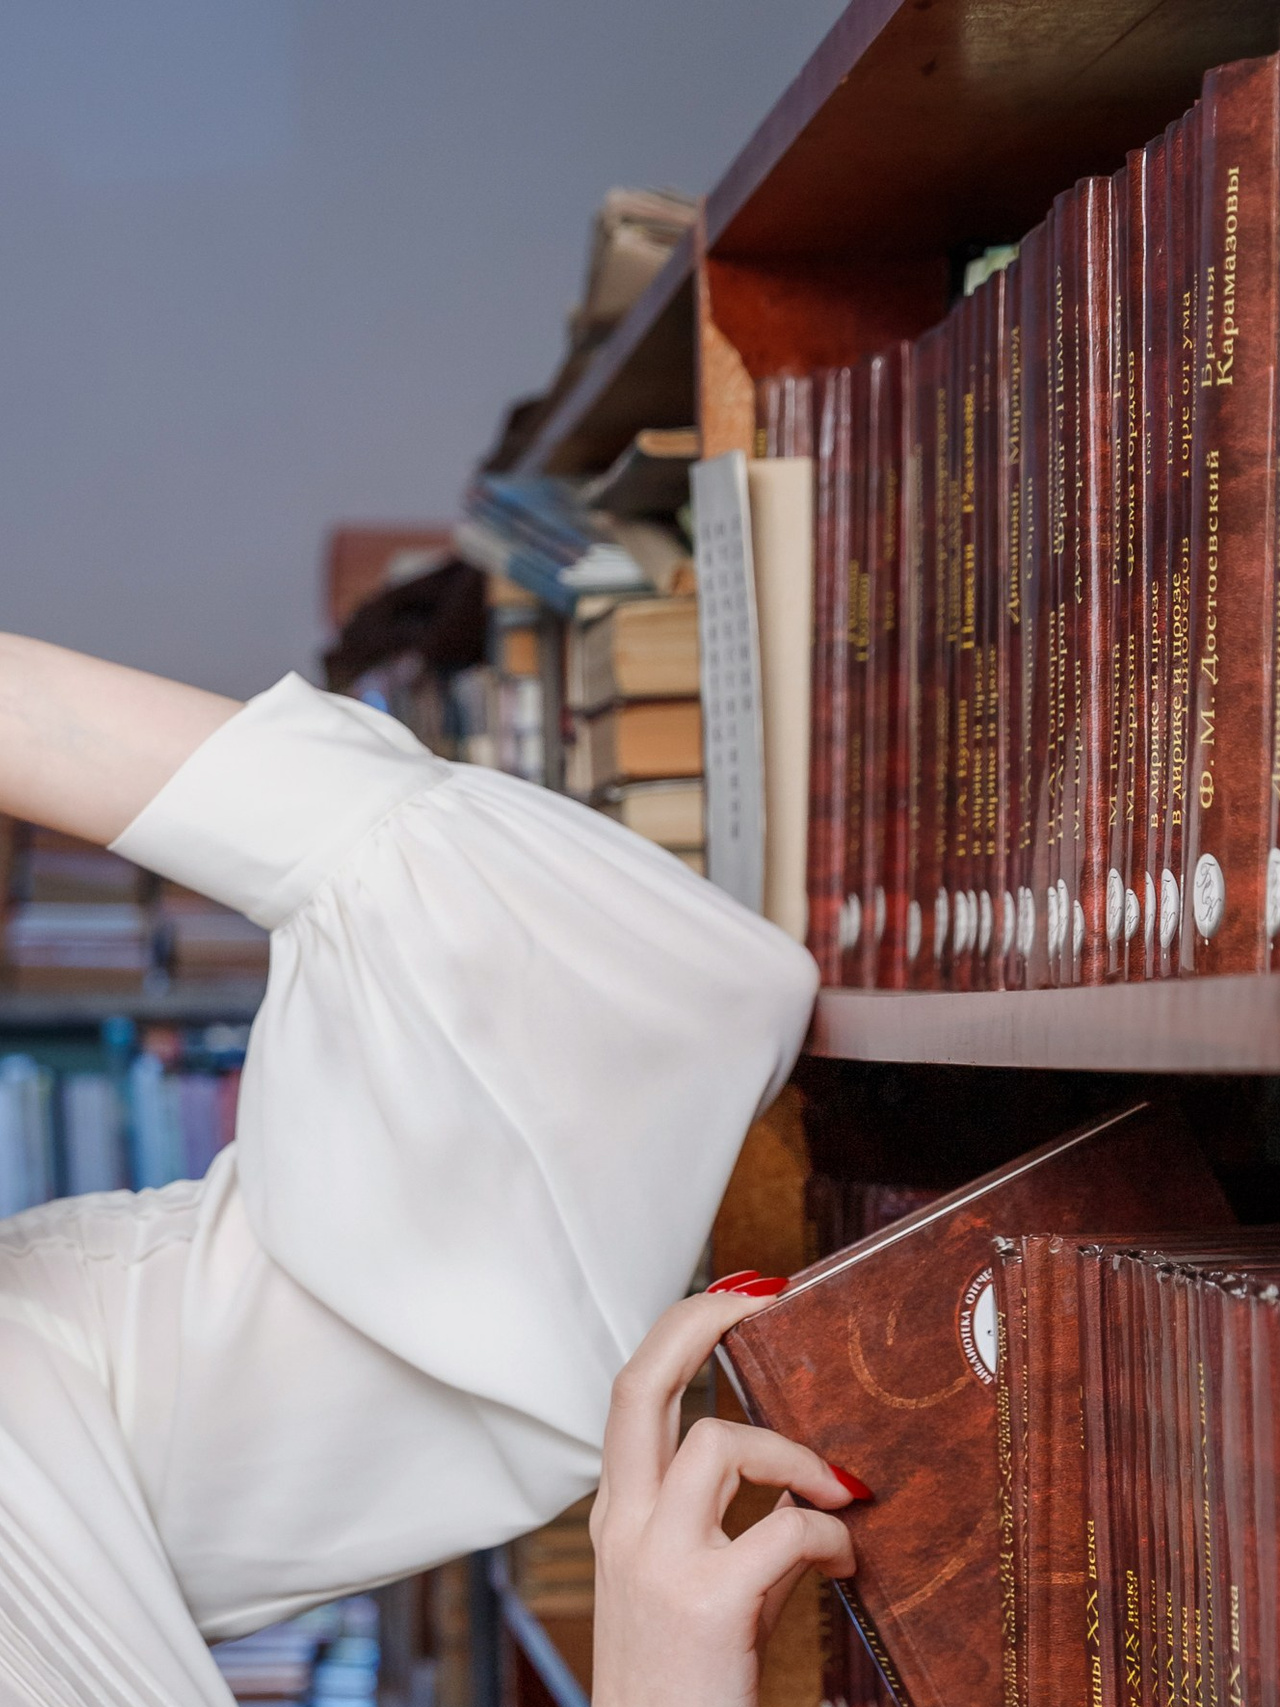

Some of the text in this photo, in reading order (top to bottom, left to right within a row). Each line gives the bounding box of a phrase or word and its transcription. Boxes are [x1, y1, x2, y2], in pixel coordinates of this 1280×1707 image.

[1216, 166, 1241, 386] Карамазовы
[1182, 291, 1193, 350] ума
[1200, 265, 1217, 388] Братья
[1128, 351, 1138, 472] Гордеев
[1181, 360, 1191, 396] от
[1181, 405, 1193, 478] Горе
[1112, 436, 1121, 586] Рассказы
[1198, 450, 1221, 809] Ф. М. Достоевский
[1110, 642, 1121, 770] Горький
[1127, 634, 1138, 764] Горький
[1150, 580, 1162, 829] в лирике и прозе
[1172, 573, 1186, 825] в лирике и прозе
[1109, 784, 1118, 826] М.
[1126, 778, 1135, 822] М.
[961, 1310, 993, 1385] БИБЛИОТЕКА
[1085, 1519, 1097, 1580] века
[1086, 1588, 1100, 1647] XX
[1125, 1569, 1134, 1623] века
[1166, 1591, 1174, 1646] века
[1230, 1584, 1240, 1653] века
[1125, 1628, 1136, 1684] XIX
[1181, 1605, 1189, 1663] века
